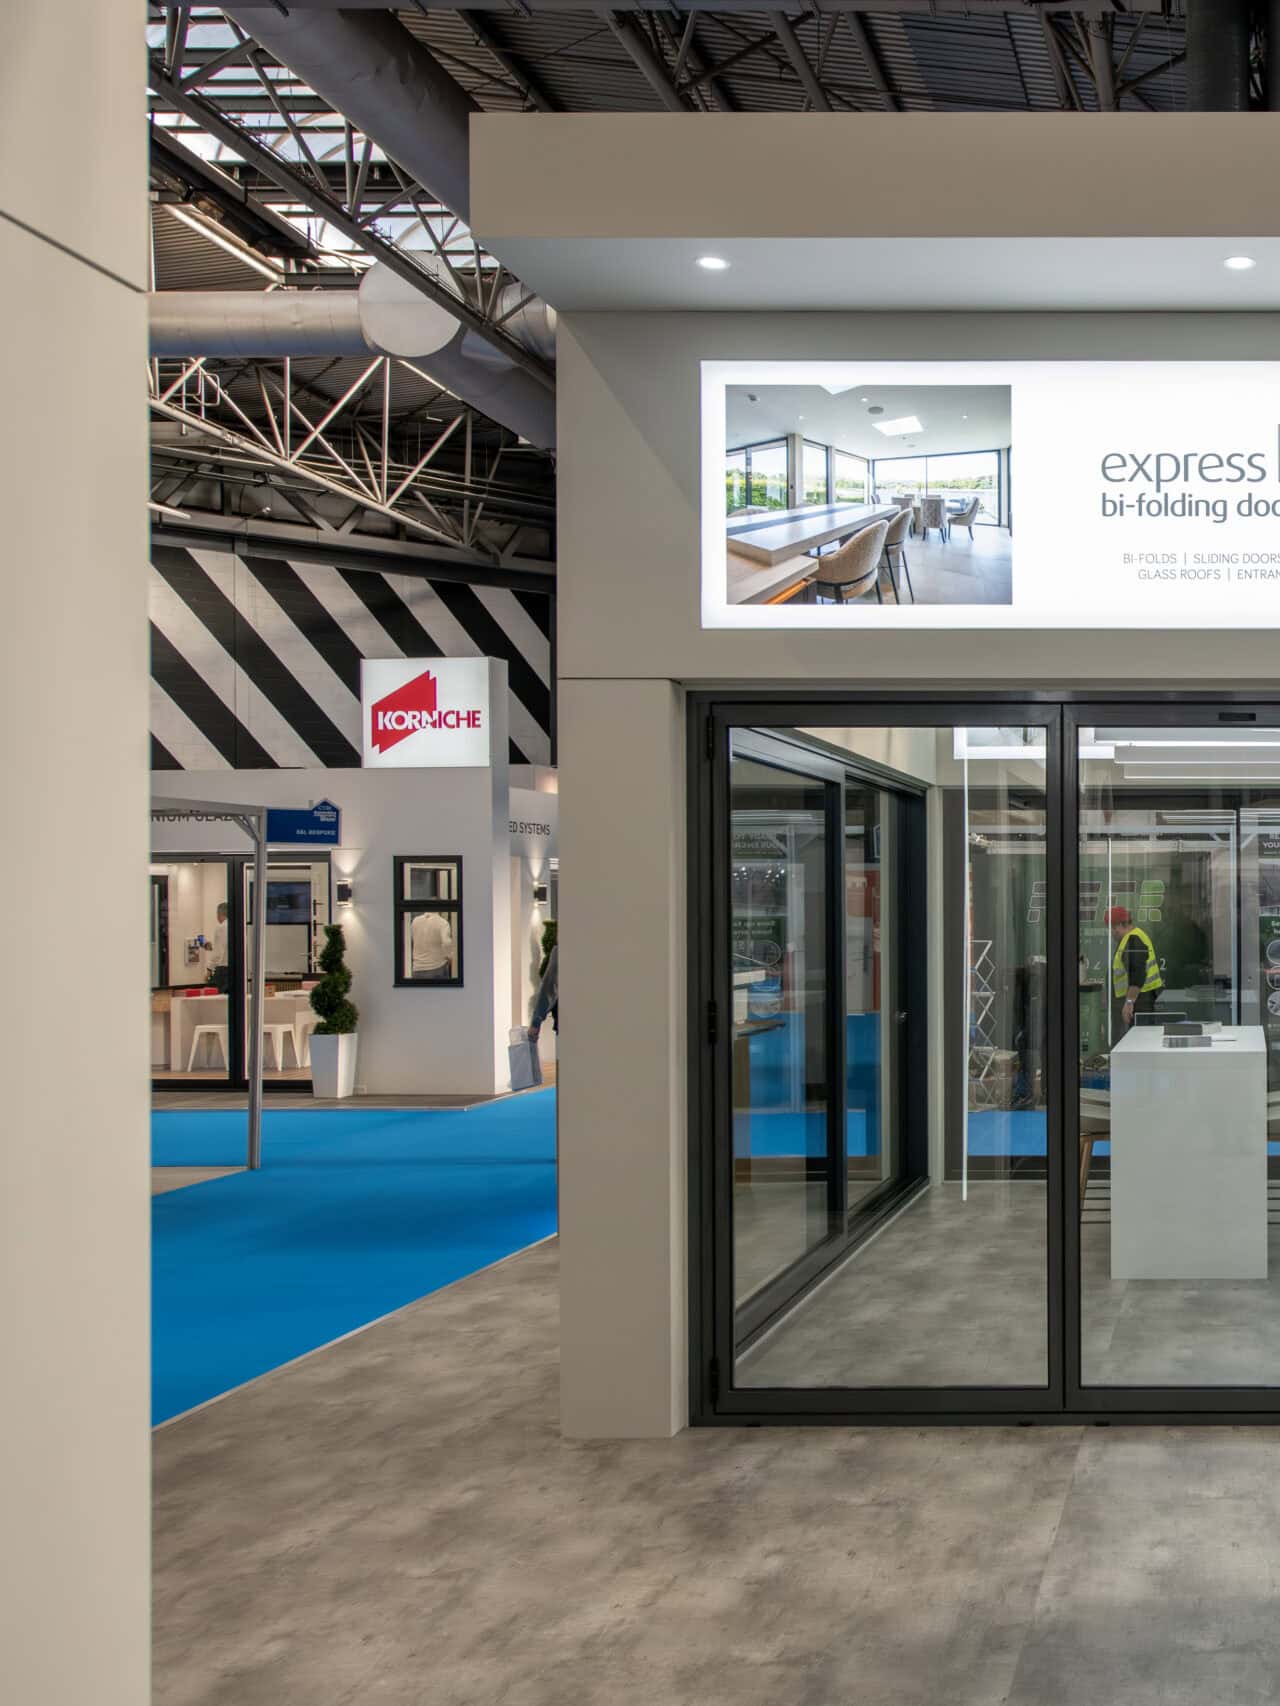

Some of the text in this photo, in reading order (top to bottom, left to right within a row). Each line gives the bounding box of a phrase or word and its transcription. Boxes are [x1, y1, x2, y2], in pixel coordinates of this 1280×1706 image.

[1101, 452, 1267, 493] express
[1102, 492, 1228, 524] bi-folding
[1122, 553, 1177, 565] BI-FOLDS
[1193, 553, 1240, 565] SLIDING
[1138, 569, 1177, 580] GLASS
[1180, 569, 1221, 580] ROOFS
[377, 710, 482, 730] KORNICHE
[519, 822, 551, 836] SYSTEMS
